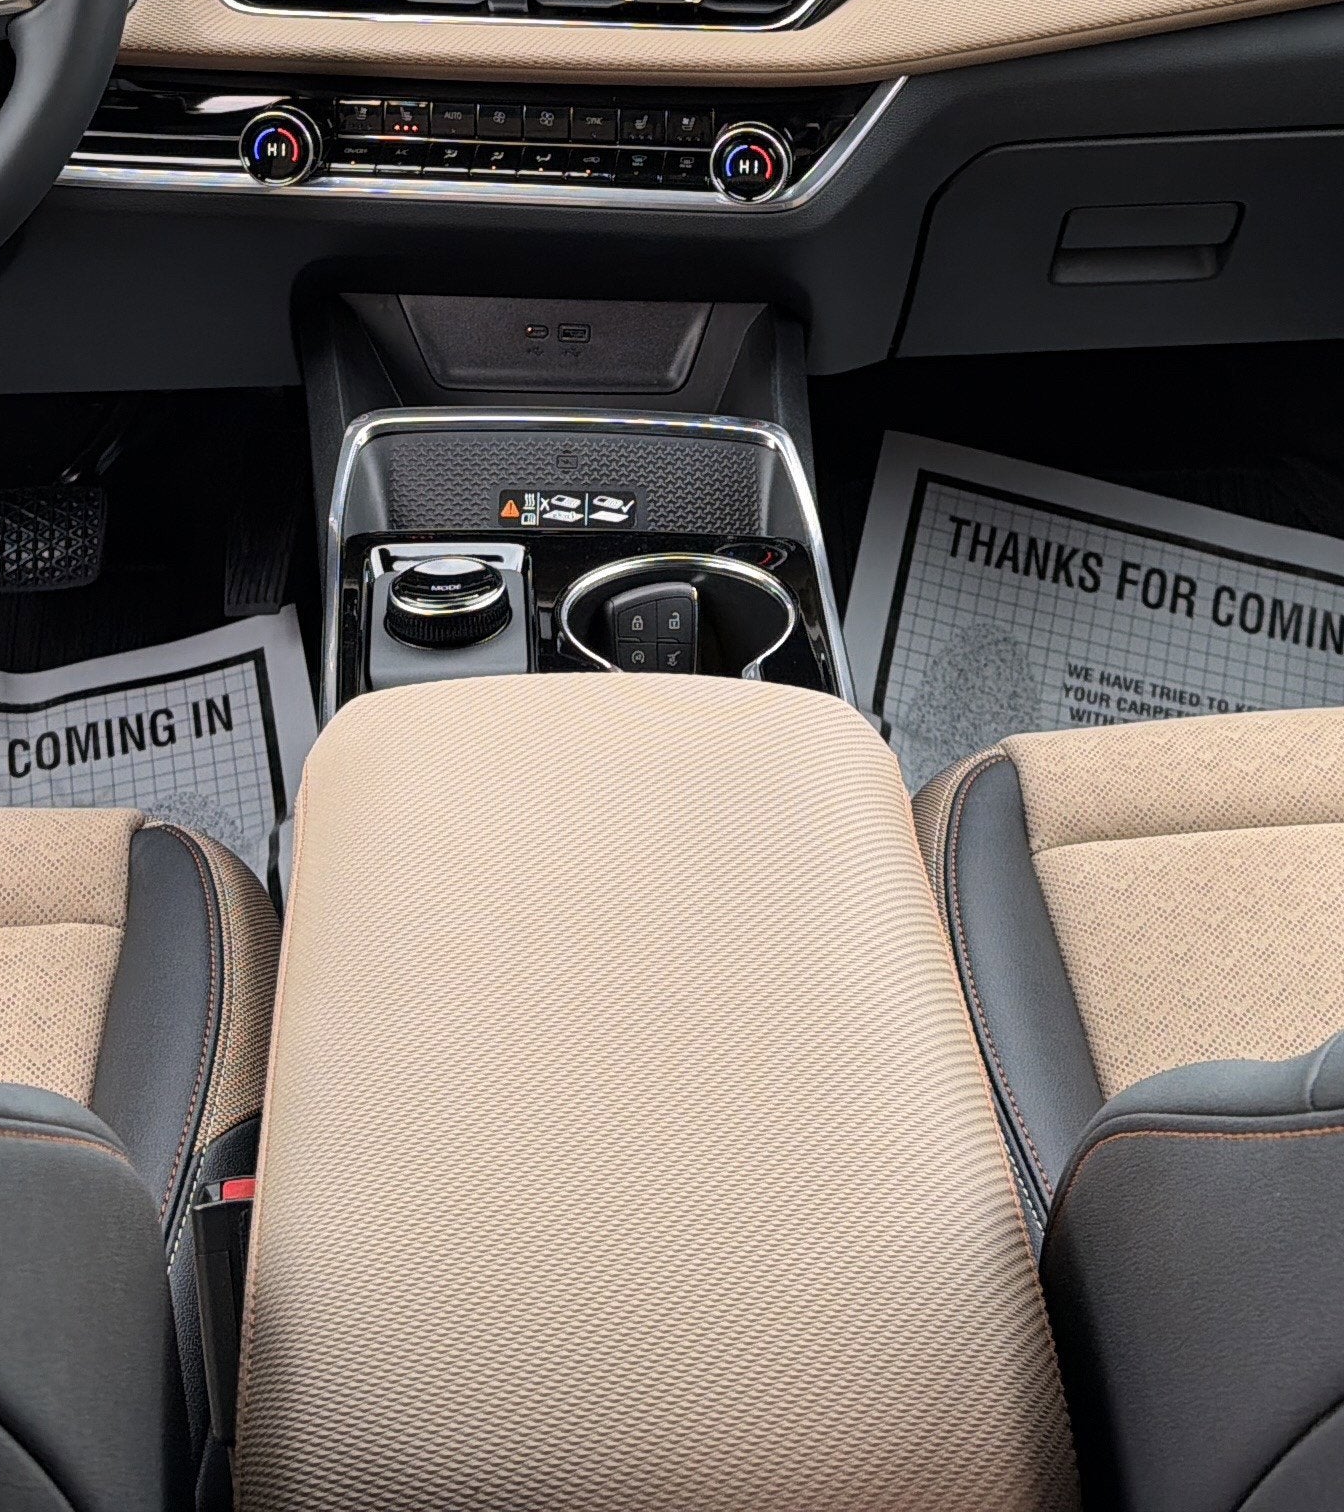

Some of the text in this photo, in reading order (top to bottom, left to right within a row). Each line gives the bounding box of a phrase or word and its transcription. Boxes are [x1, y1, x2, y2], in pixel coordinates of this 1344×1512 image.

[443, 111, 463, 121] AUTO
[585, 116, 604, 126] SYNC
[267, 142, 286, 157] HI
[739, 159, 759, 175] HI
[945, 514, 1105, 595] THANKS
[1116, 561, 1199, 618] FOR
[430, 583, 462, 592] MODE
[1062, 682, 1112, 710] YOUR
[1066, 661, 1095, 683] WE
[1098, 670, 1146, 696] HAVE
[1149, 682, 1201, 708] TRIED
[1206, 696, 1230, 714] TO
[1068, 706, 1115, 726] WITH
[6, 706, 178, 780] COMING
[191, 693, 236, 739] IN
